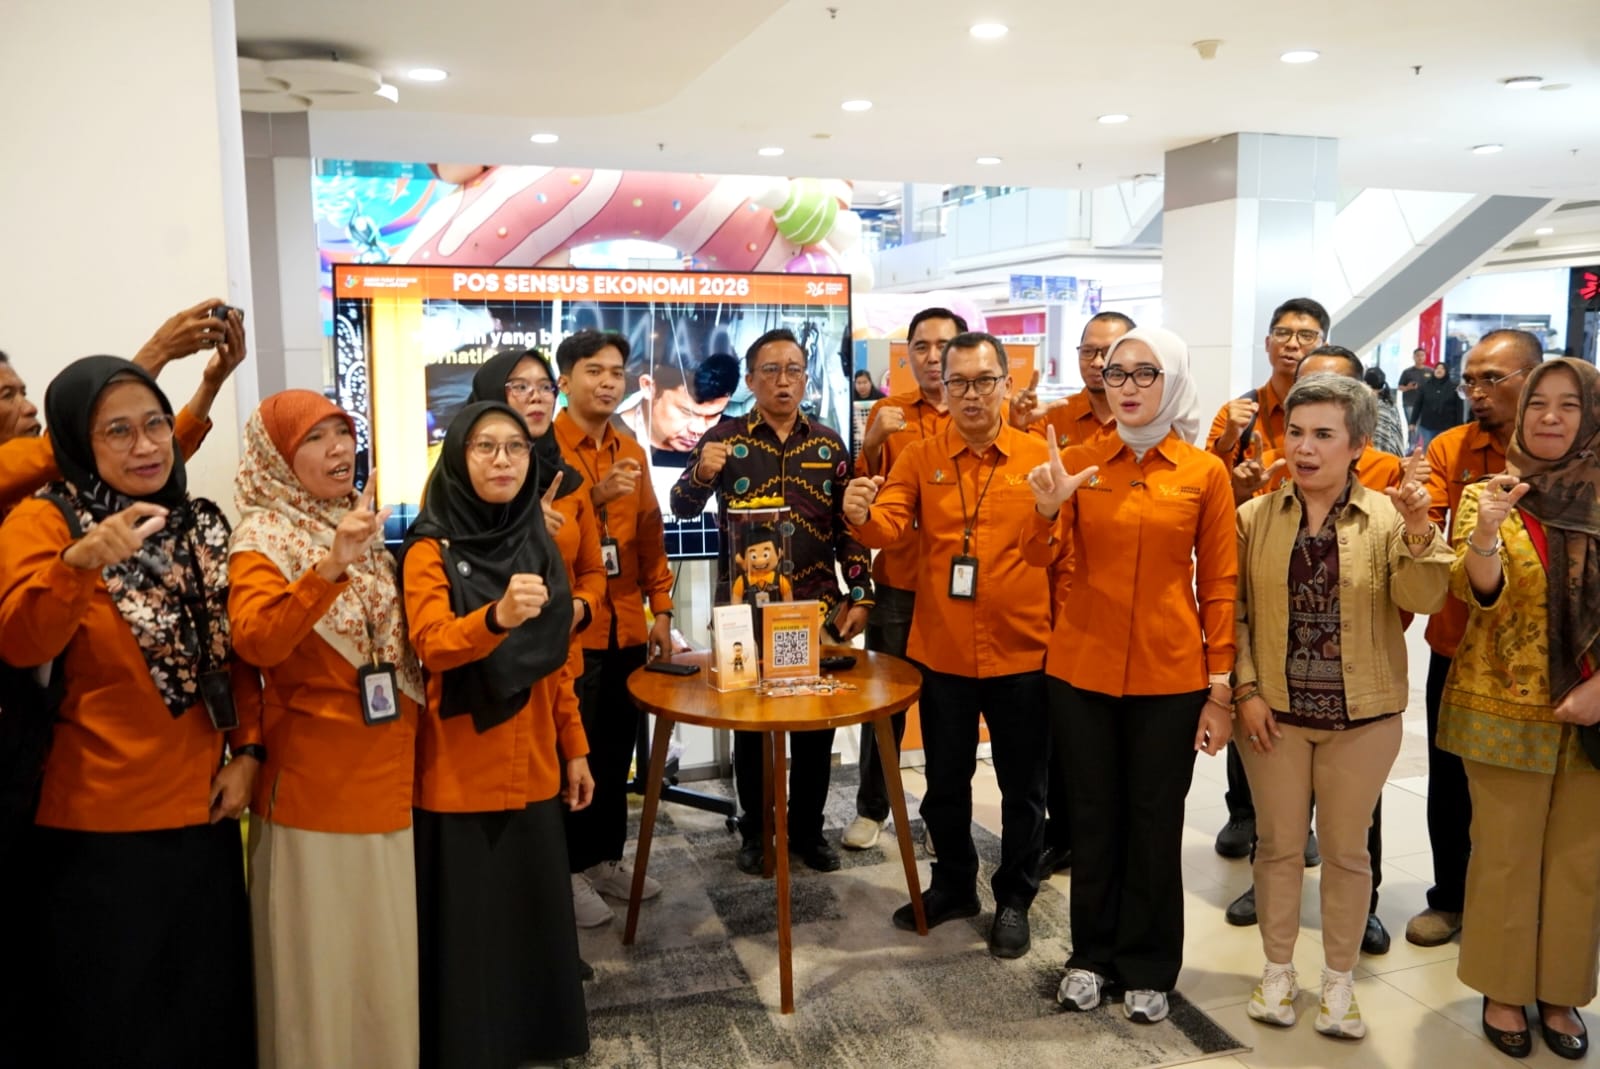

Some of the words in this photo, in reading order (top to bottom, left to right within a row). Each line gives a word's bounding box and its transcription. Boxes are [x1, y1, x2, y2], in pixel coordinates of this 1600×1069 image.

[453, 273, 499, 293] POS
[504, 274, 589, 294] SENSUS
[593, 276, 695, 295] EKONOMI
[699, 277, 750, 297] 2026
[490, 331, 536, 348] yang
